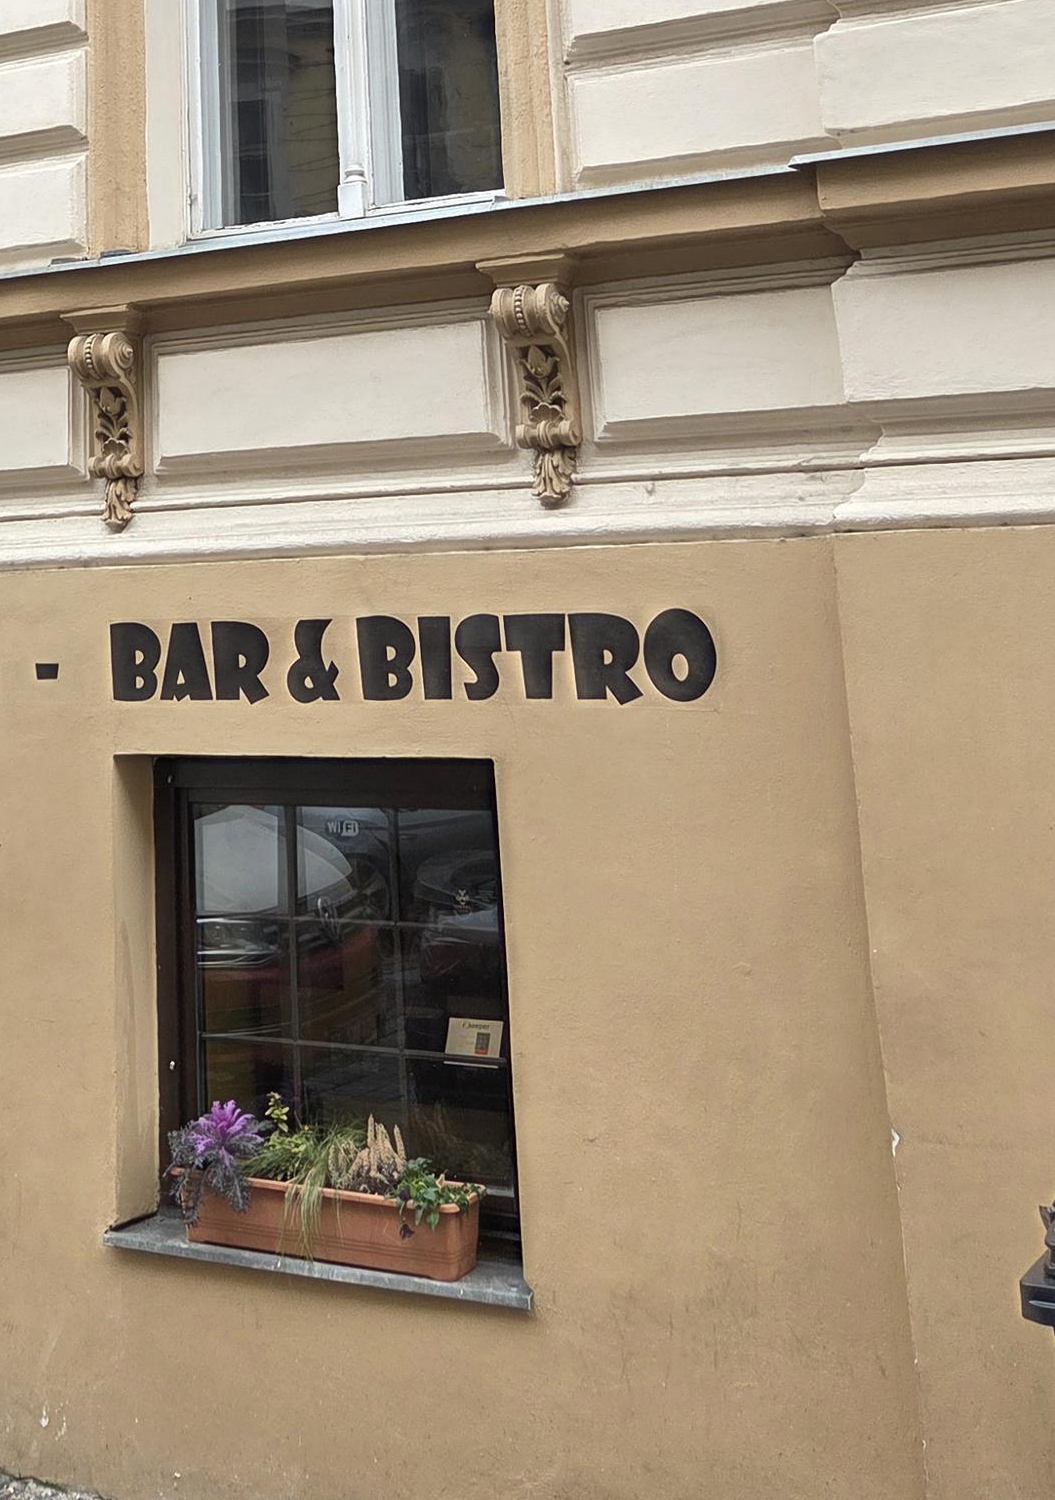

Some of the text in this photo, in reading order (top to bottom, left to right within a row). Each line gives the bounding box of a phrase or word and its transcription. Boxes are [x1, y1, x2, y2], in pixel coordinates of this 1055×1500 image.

[109, 620, 270, 705] BAR
[286, 618, 341, 704] &
[355, 608, 717, 706] BISTRO
